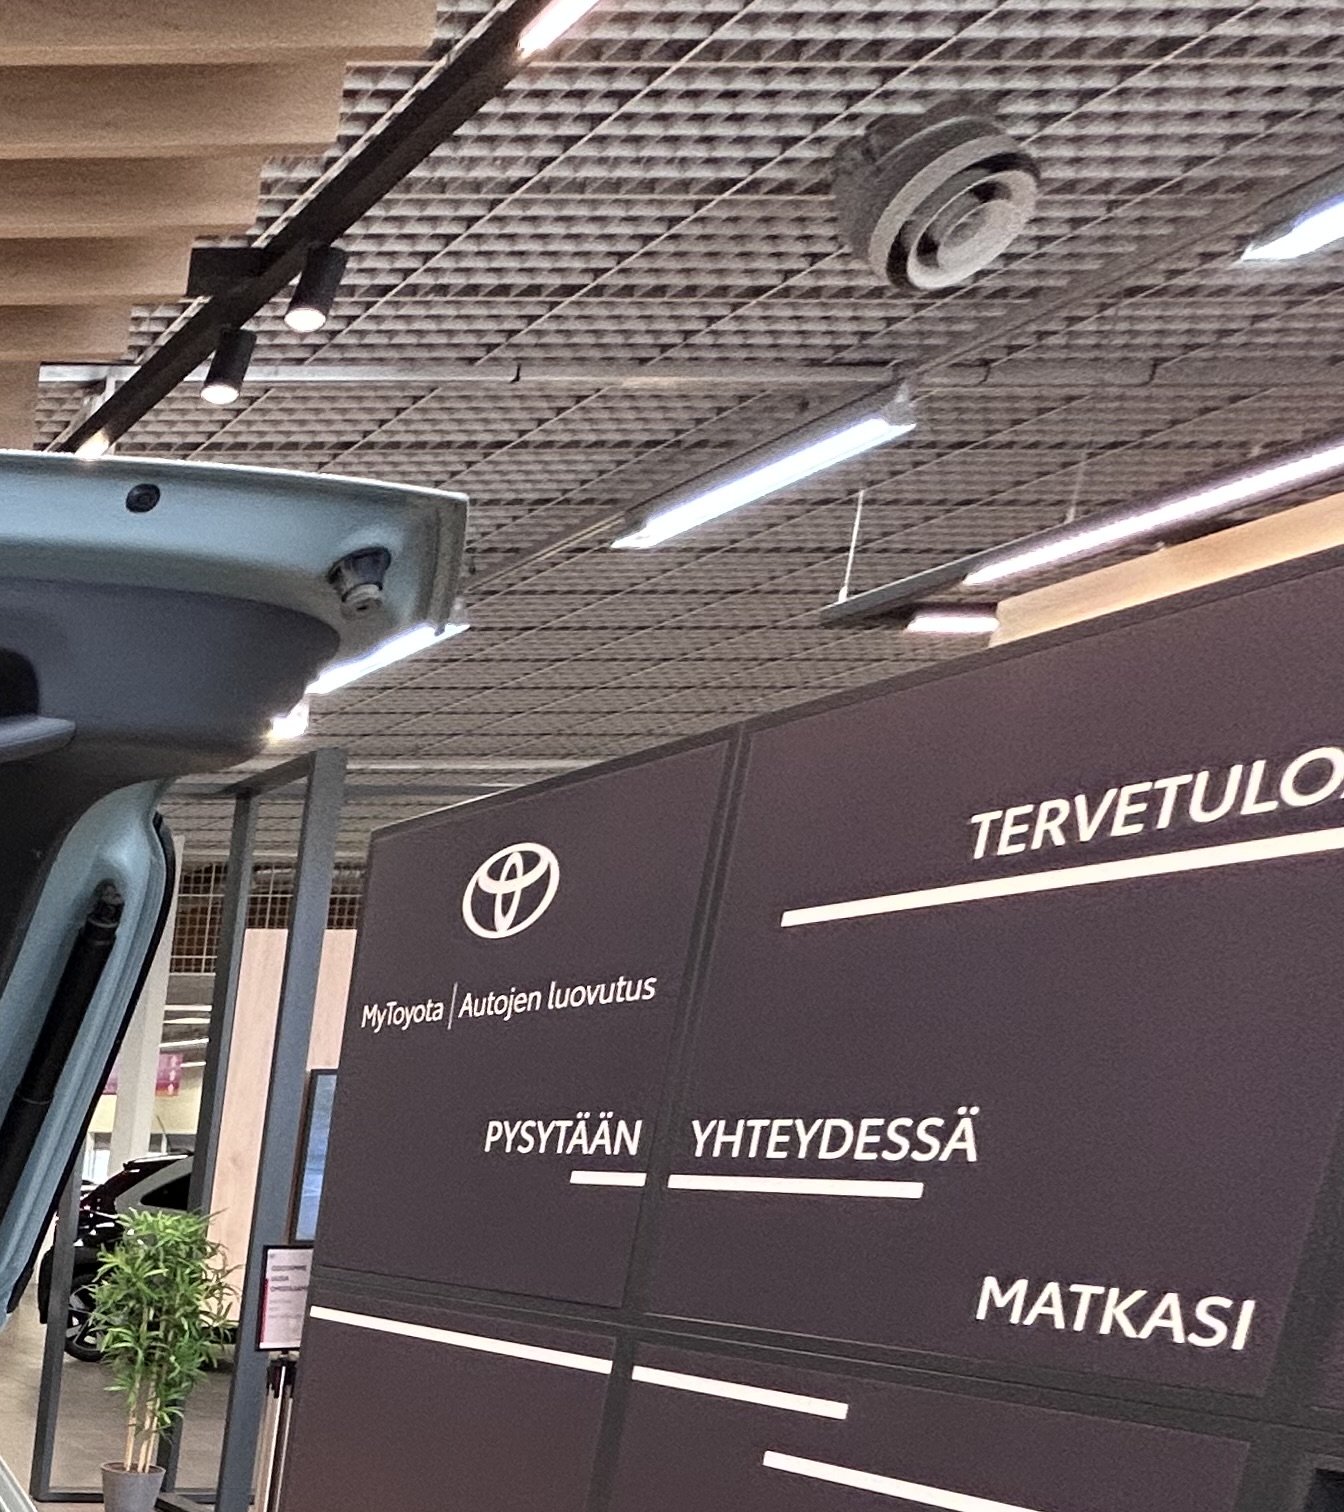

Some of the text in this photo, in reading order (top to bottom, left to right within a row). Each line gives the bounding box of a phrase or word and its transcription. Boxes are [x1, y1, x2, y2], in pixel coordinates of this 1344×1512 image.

[970, 746, 1344, 860] TERVETULO
[360, 975, 658, 1034] MyToyota Autojen luovutus
[484, 1105, 980, 1162] PYSYTÄÄN YHTEYDESSÄ
[975, 1275, 1256, 1351] MATKASI
